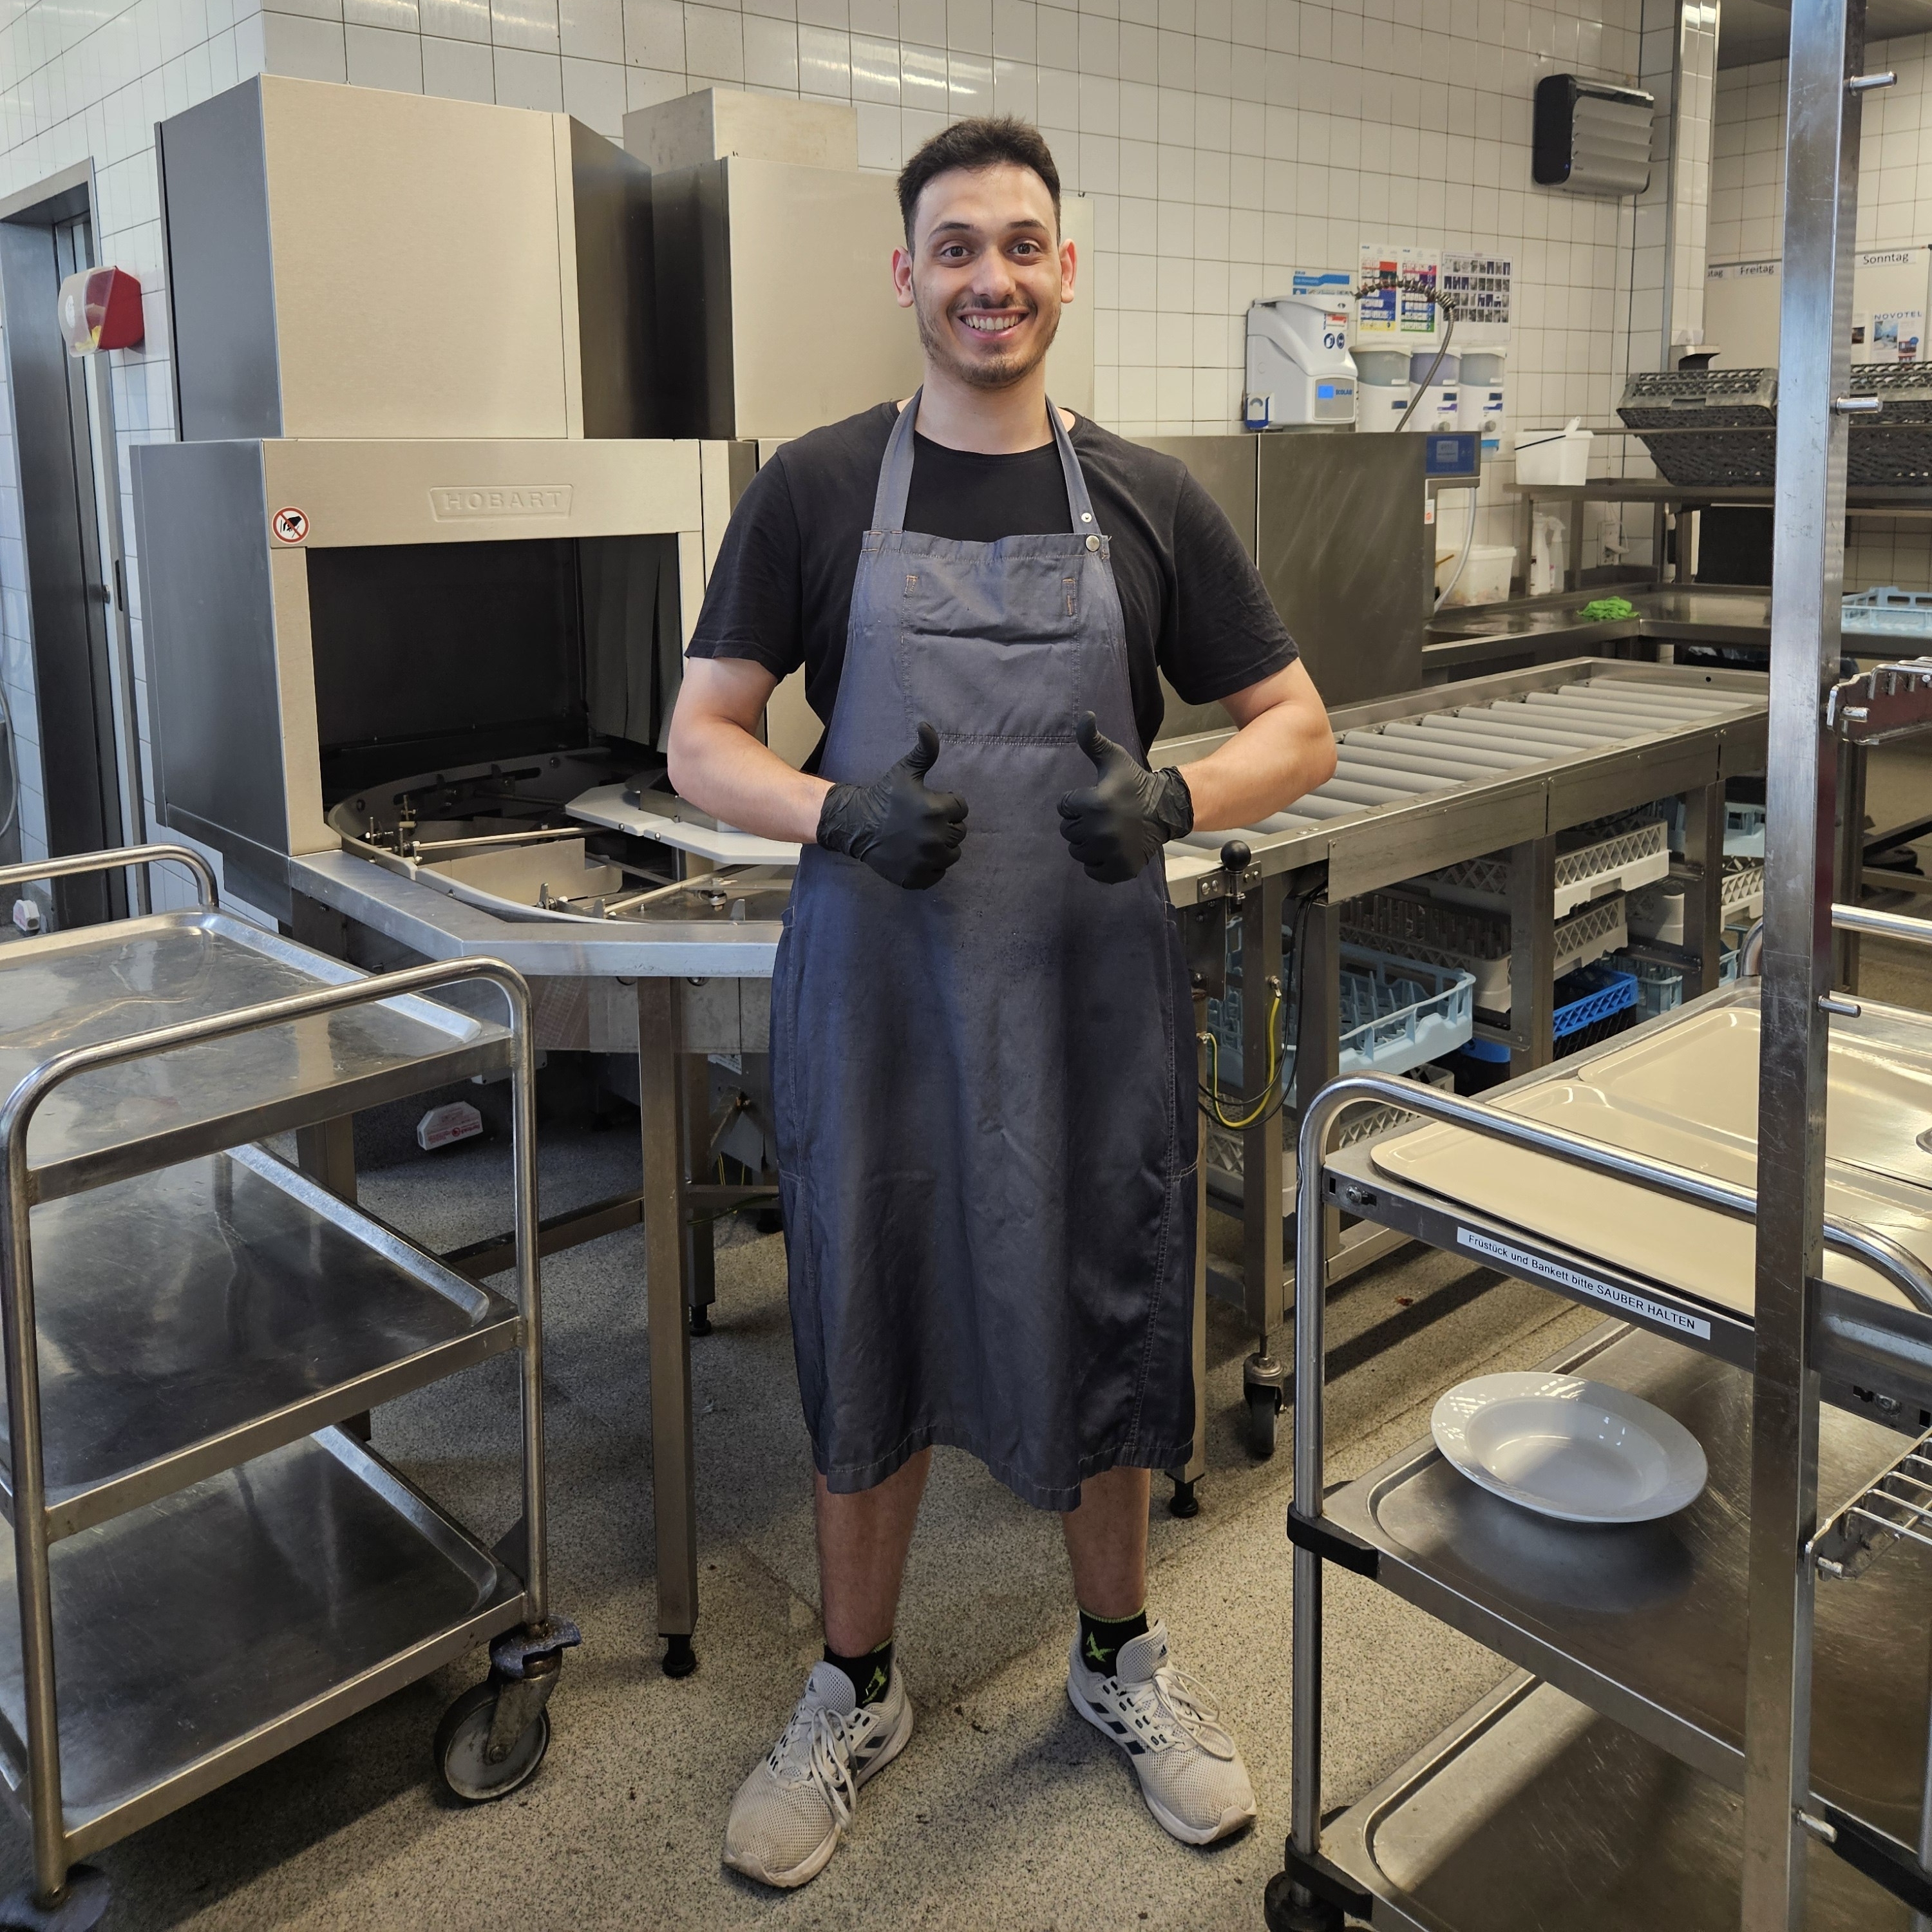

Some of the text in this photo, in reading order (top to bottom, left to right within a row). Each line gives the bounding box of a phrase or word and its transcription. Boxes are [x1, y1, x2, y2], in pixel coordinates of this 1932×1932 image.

[1863, 253, 1909, 265] Sonntag
[1740, 265, 1774, 275] Freitag
[1874, 311, 1922, 320] NOVOTEL
[444, 491, 562, 509] HOBART
[1469, 1235, 1695, 1329] Früstück und Bankett bitte SAUBER HALTEN
